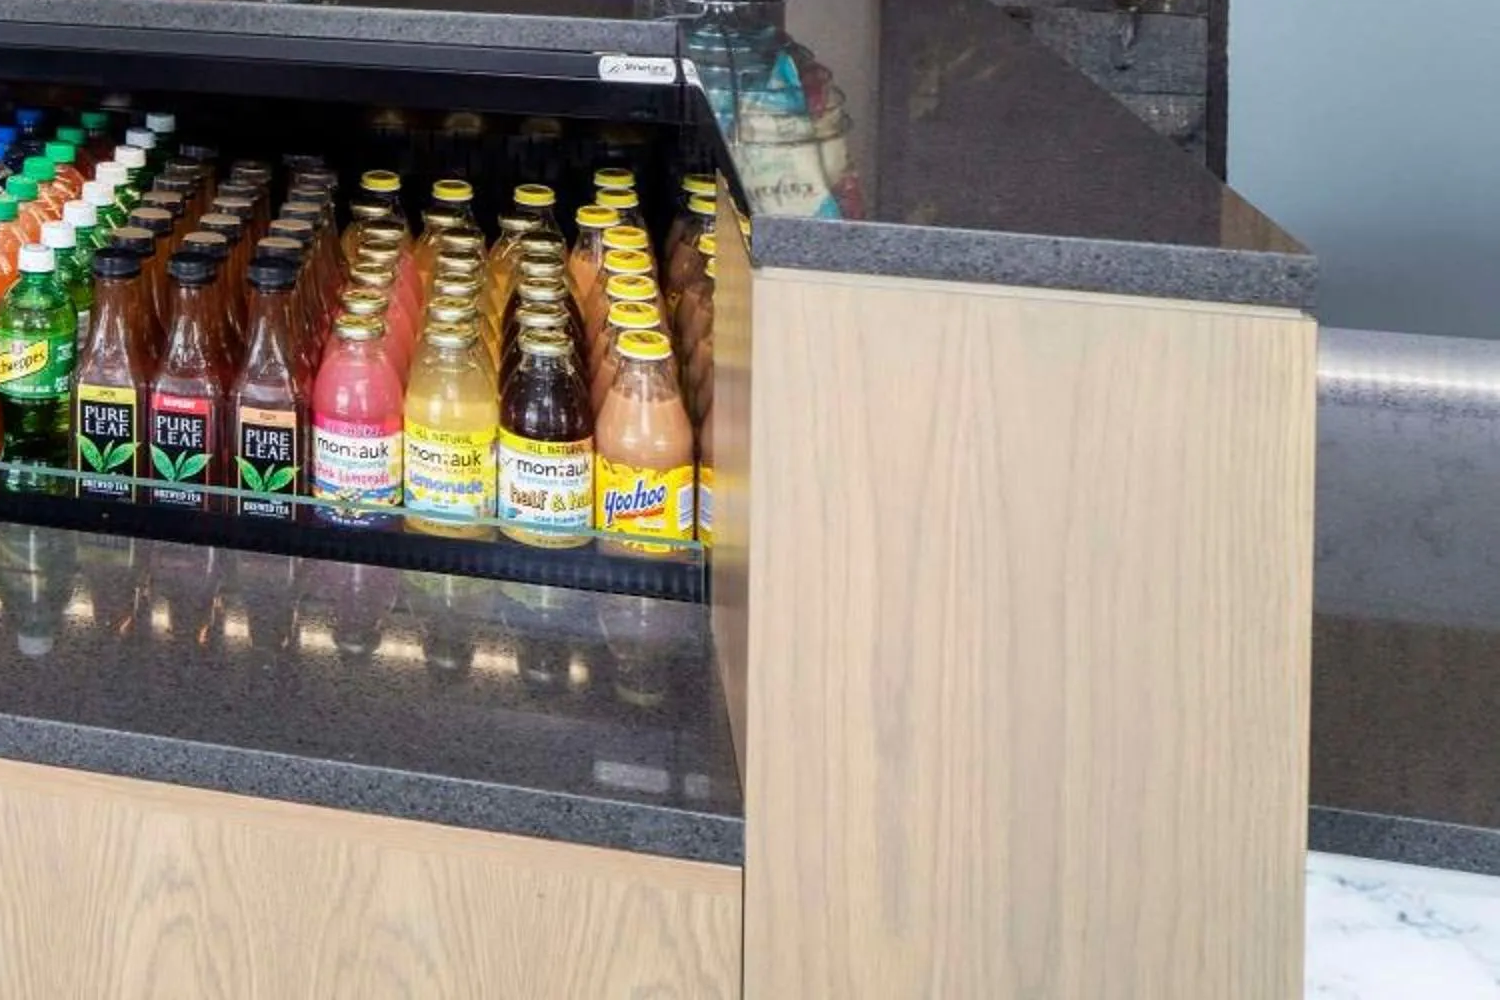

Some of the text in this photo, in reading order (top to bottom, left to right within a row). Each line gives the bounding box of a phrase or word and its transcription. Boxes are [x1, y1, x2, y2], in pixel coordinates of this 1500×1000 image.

[84, 405, 129, 422] PURE
[156, 416, 203, 433] PURE
[245, 429, 291, 447] PURE
